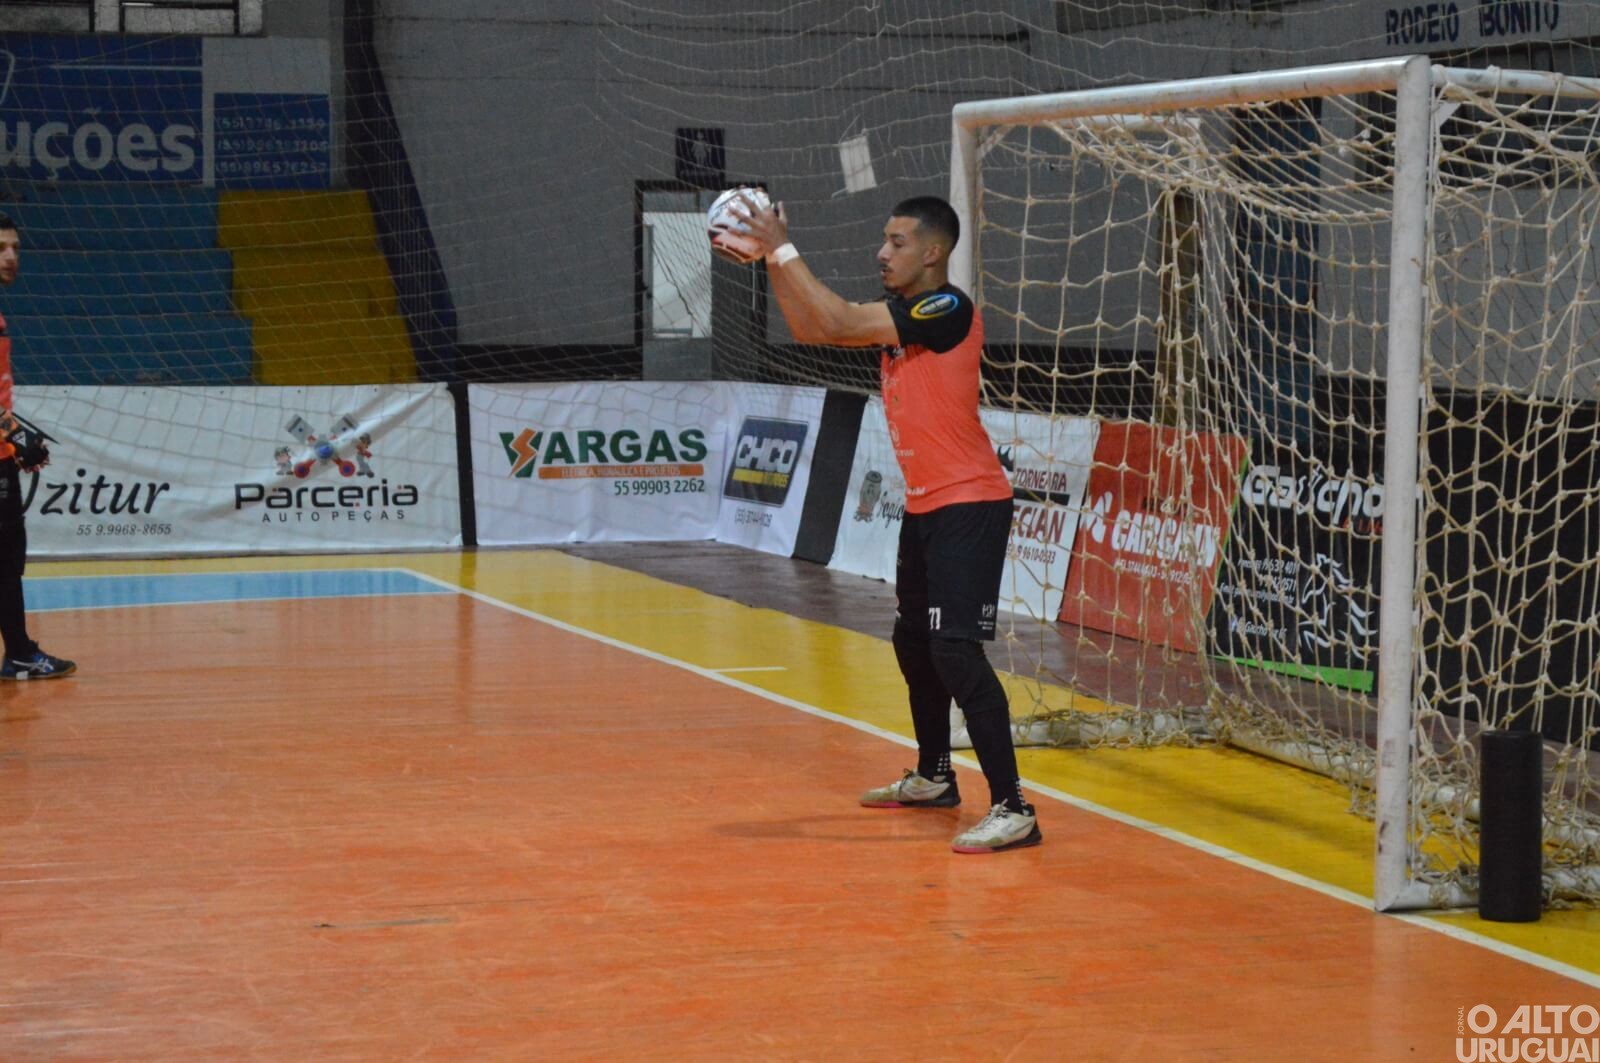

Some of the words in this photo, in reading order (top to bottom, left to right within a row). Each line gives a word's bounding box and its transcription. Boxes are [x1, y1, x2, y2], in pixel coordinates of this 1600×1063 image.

[1386, 3, 1460, 46] RODEIO
[1479, 0, 1559, 37] BONITO
[499, 428, 708, 478] VARGAS
[735, 435, 799, 473] CHICO
[234, 478, 419, 510] Parceria
[614, 480, 630, 496] 55
[632, 480, 671, 495] 99903
[673, 478, 705, 493] 2262
[77, 525, 92, 536] 55
[262, 512, 320, 523] AUTO
[331, 510, 405, 523] PEÇAS
